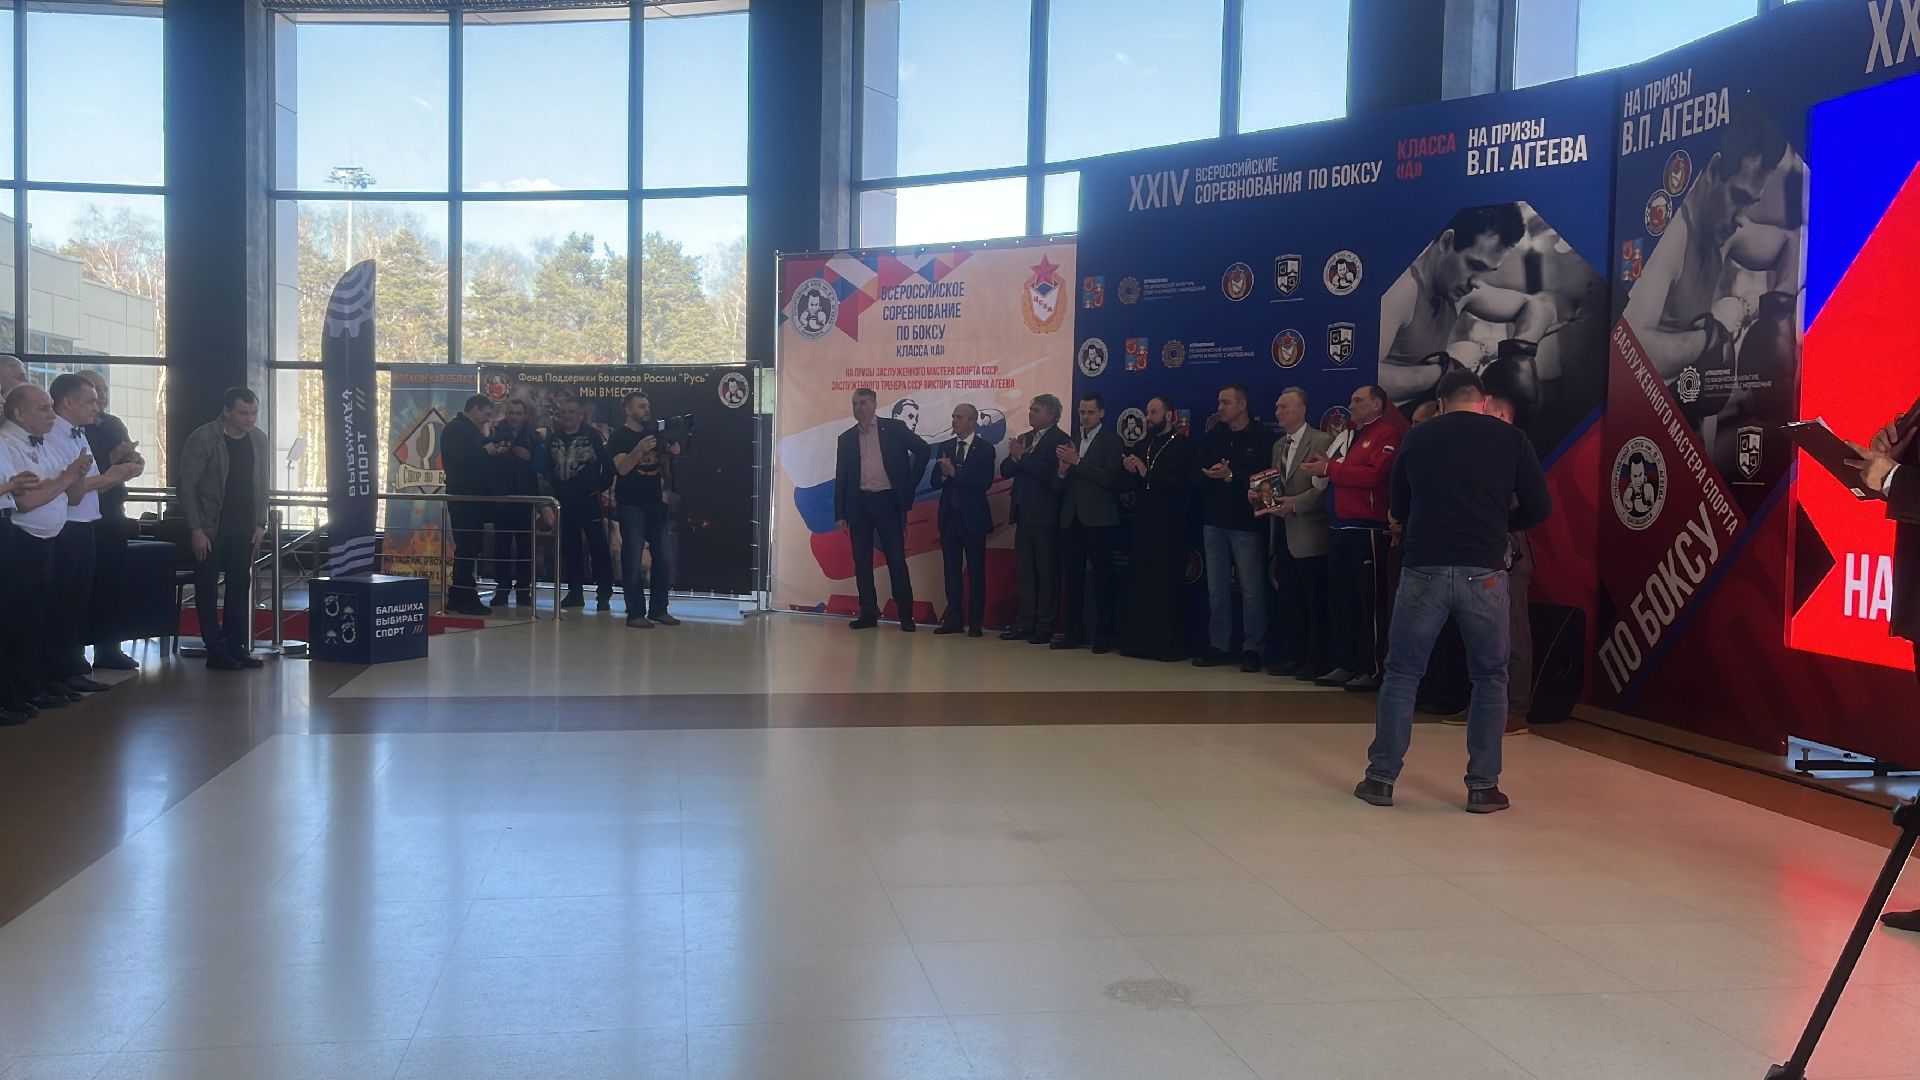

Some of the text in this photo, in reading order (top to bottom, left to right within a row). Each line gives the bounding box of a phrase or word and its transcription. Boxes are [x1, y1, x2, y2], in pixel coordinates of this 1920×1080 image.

[1624, 68, 1691, 117] НА ПРИЗЫ
[1468, 118, 1545, 148] НА ПРИЗЫ
[1622, 87, 1730, 156] В.П. АГЕЕВА
[1397, 133, 1456, 160] КЛАССА
[1467, 135, 1588, 176] В.П. АГЕЕВА
[1195, 157, 1279, 182] ВСЕРОССИЙСКИЕ
[1128, 169, 1190, 212] XXIV
[1195, 160, 1383, 205] СОРЕВНОВАНИЯ ПО БОКСУ
[881, 282, 965, 300] ВСЕРОССИЙСКОЕ
[883, 303, 961, 320] СОРЕВНОВАНИЕ
[897, 324, 946, 340] ПО БОКСУ
[896, 345, 928, 357] КЛАССА
[518, 372, 544, 383] Фонд
[545, 372, 597, 384] Поддержки
[598, 372, 641, 385] Боксеров
[643, 373, 677, 383] России
[846, 368, 853, 377] НА
[855, 368, 875, 377] ПРИЗЫ
[876, 367, 926, 377] ЗАСЛУЖЕННОГО
[927, 366, 955, 376] МАСТЕРА
[956, 366, 980, 376] СПОРТА
[580, 387, 597, 398] МЫ
[881, 380, 907, 391] ТРЕНЕРА
[908, 381, 923, 390] СССР
[924, 380, 951, 389] ВИКТОРА
[953, 380, 989, 389] ПЕТРОВИЧА
[990, 379, 1015, 389] АГЕЕВА
[1613, 326, 1739, 536] ЗАСЛУЖЕННОГО МАСТЕРА СПОРТА
[358, 431, 370, 496] СПОРТ
[1599, 501, 1719, 694] ПО БОКСУ
[1843, 552, 1893, 622] НА
[375, 602, 424, 615] БАЛАШИХА
[375, 613, 424, 627] ВЫБИРАЕТ
[375, 626, 405, 638] СПОРТ
